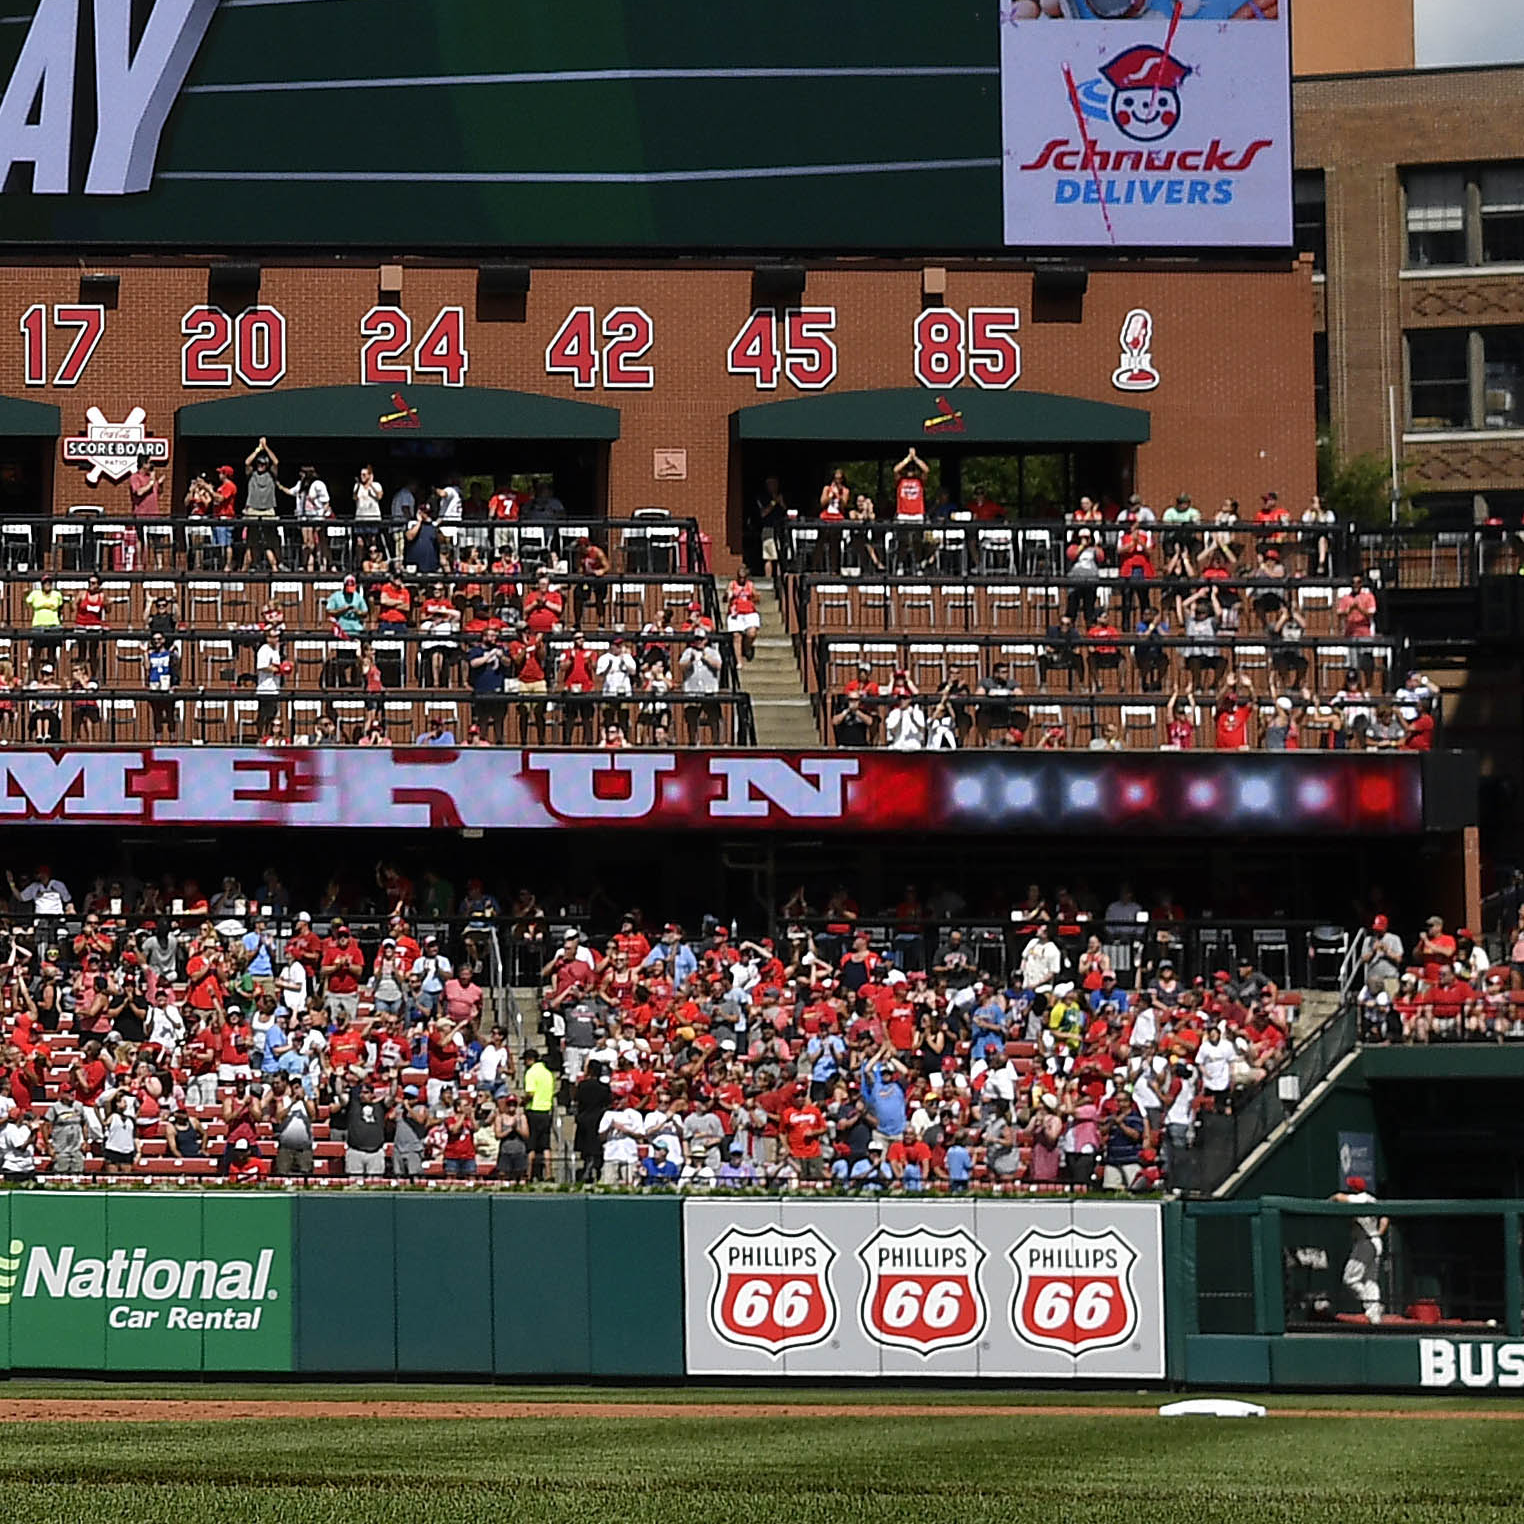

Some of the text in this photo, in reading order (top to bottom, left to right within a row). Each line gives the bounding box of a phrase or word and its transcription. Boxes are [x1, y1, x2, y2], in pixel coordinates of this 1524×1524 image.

[1020, 138, 1273, 172] Schnucks
[1055, 179, 1234, 206] DELIVERS
[20, 304, 105, 386] 17
[181, 305, 287, 387] 20
[360, 305, 468, 388] 24
[545, 306, 654, 388] 42
[727, 307, 838, 390] 45
[914, 307, 1021, 390] 85
[68, 442, 165, 456] SCOREBOARD
[21, 1246, 273, 1301] National
[728, 1246, 818, 1268] PHILLIPS
[878, 1246, 968, 1268] PHILLIPS
[1029, 1247, 1119, 1269] PHILLIPS
[108, 1306, 261, 1330] Car Rental
[732, 1279, 811, 1328] 66
[883, 1279, 962, 1328] 66
[1033, 1280, 1112, 1329] 66
[1419, 1338, 1524, 1387] BUS
